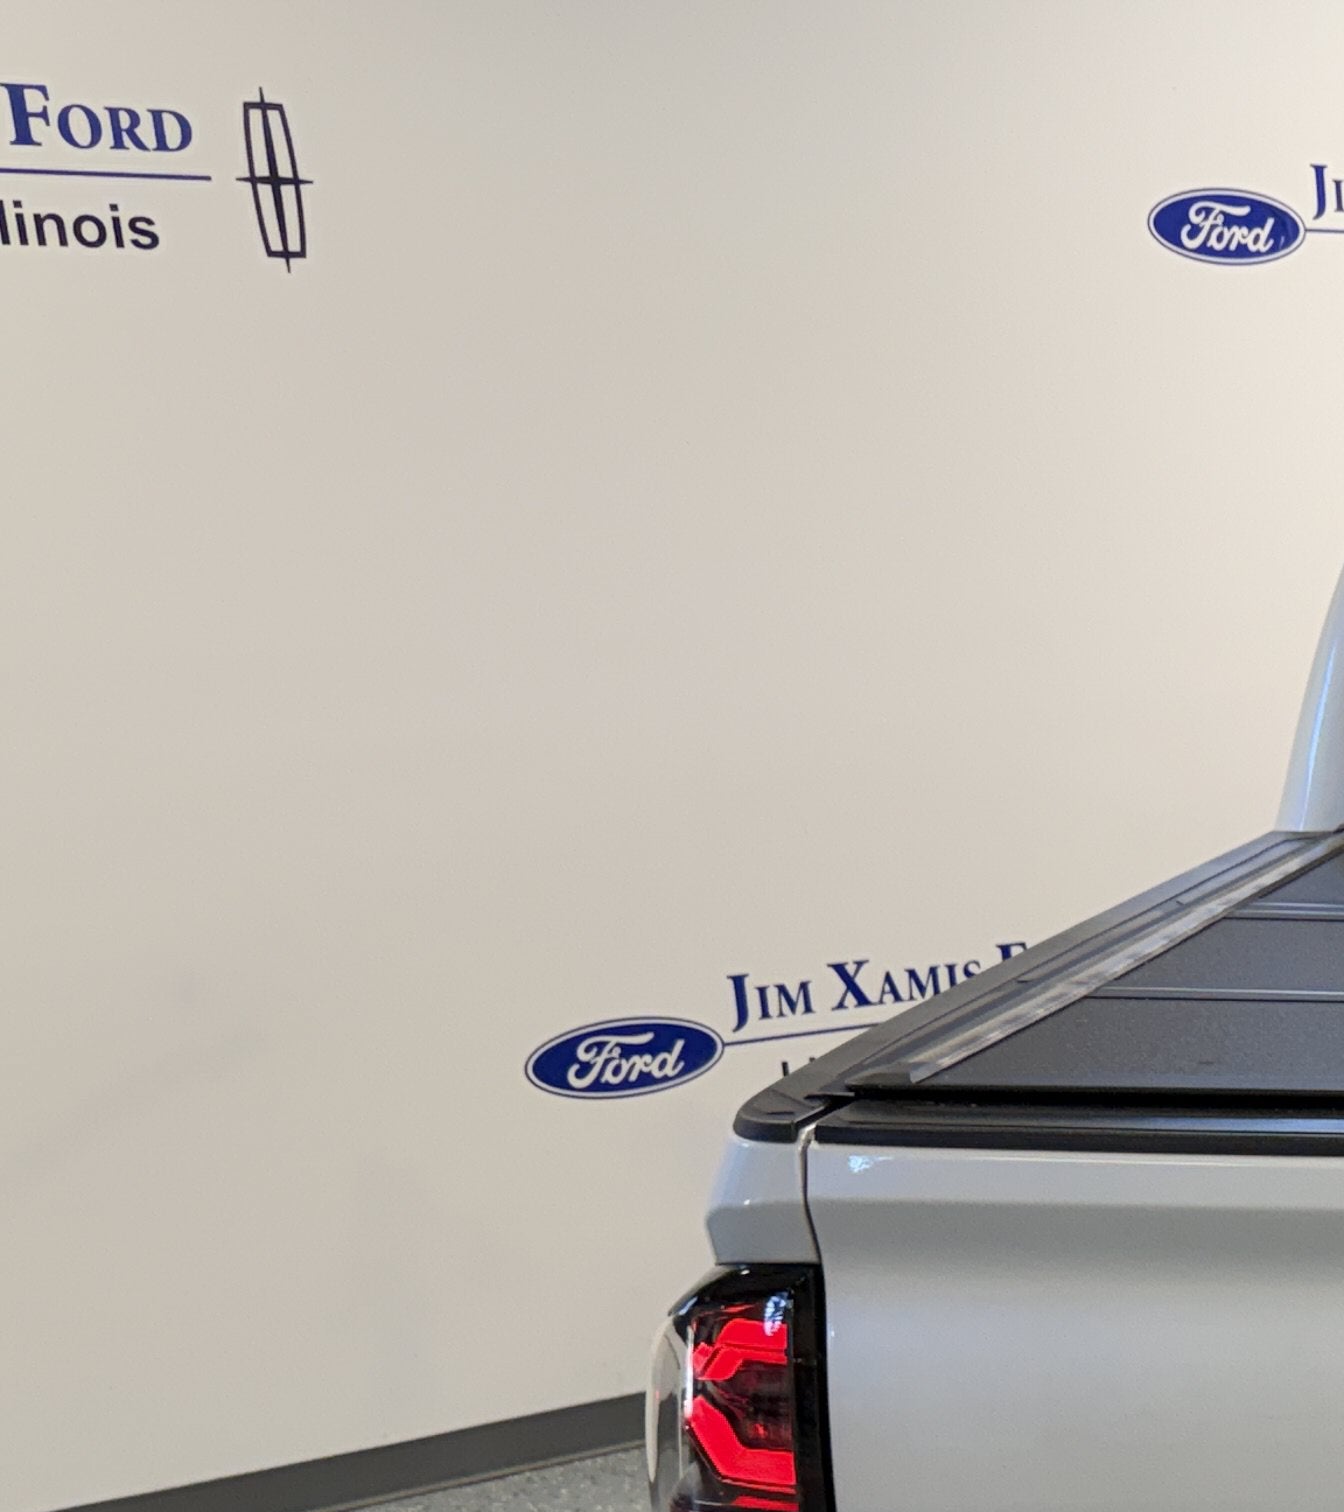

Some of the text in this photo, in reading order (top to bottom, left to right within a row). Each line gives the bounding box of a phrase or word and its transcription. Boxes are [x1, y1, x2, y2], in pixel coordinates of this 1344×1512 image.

[0, 82, 193, 152] FORD
[0, 199, 160, 250] linois
[1181, 200, 1274, 254] Ford
[727, 973, 814, 1033] JIM
[566, 1032, 684, 1091] Ford
